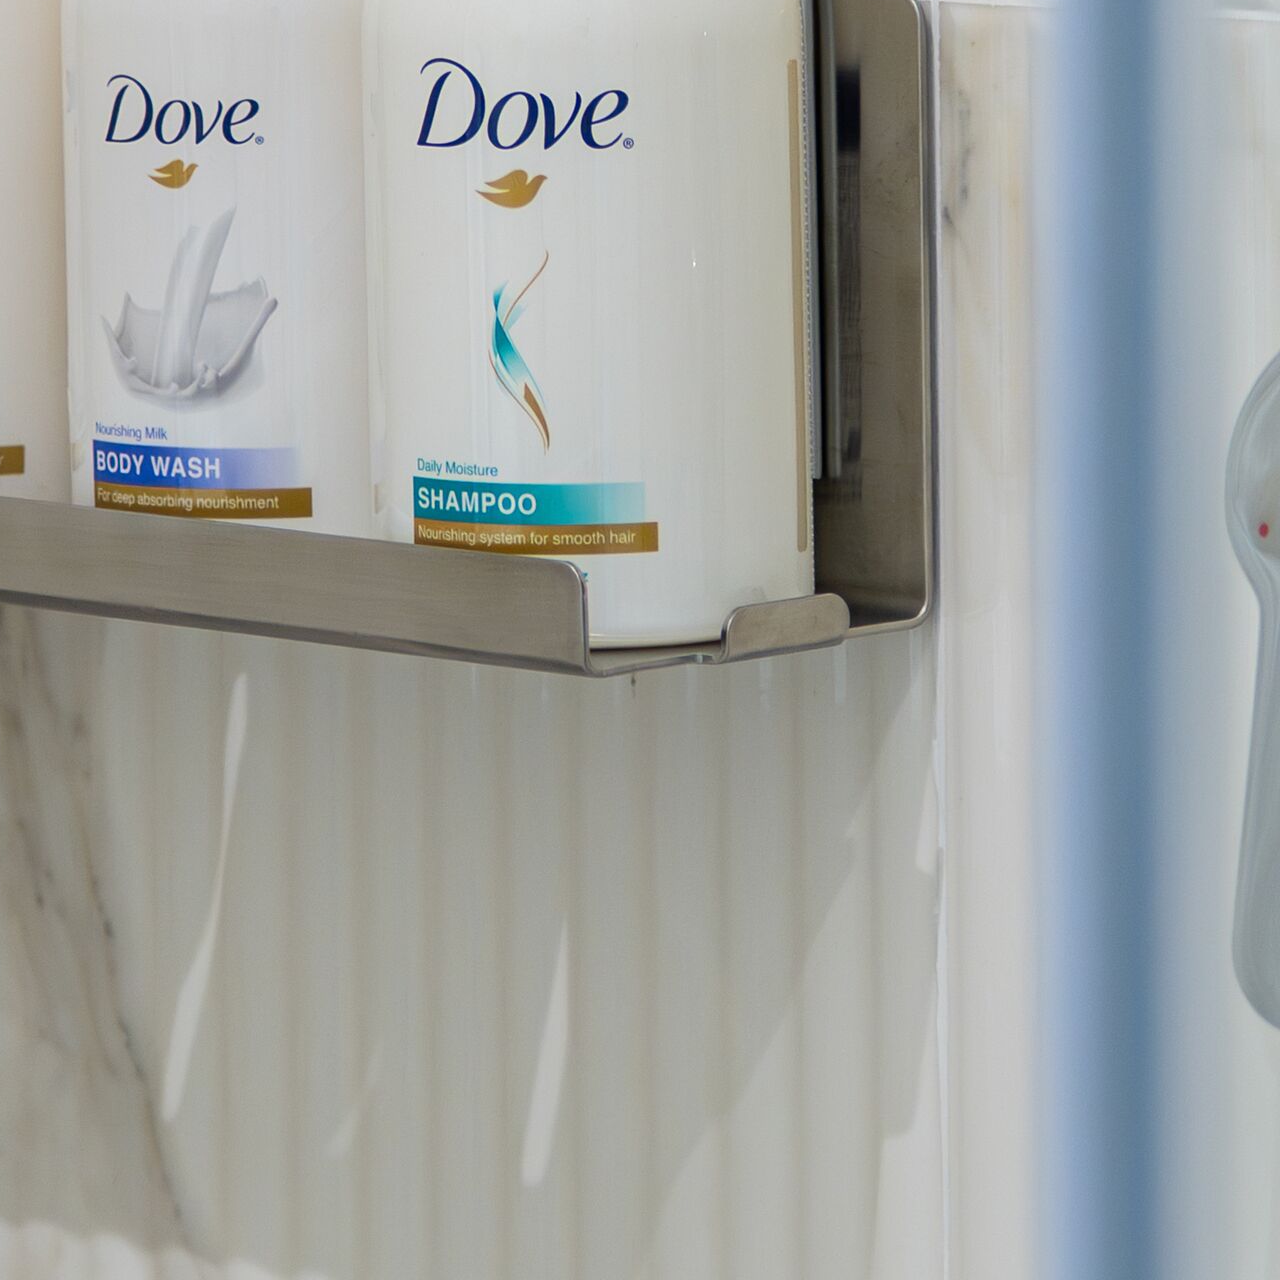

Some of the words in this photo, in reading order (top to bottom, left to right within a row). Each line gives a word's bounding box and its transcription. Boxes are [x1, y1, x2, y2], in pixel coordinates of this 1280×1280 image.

[104, 74, 260, 145] Dove
[417, 57, 630, 150] Dove
[95, 421, 142, 442] Nourishing
[145, 426, 167, 440] Milk
[96, 449, 144, 475] BODY
[151, 455, 220, 479] WASH
[417, 458, 443, 474] Daily
[445, 462, 499, 477] Moisture
[97, 487, 111, 501] For
[112, 490, 135, 508] deep
[137, 494, 194, 511] absorbing
[196, 495, 280, 509] nourishment
[418, 486, 537, 516] SHAMPOO
[418, 524, 477, 545] Nourishing
[479, 531, 528, 547] system
[530, 531, 548, 545] for
[552, 530, 606, 546] smooth
[609, 529, 636, 544] hair
